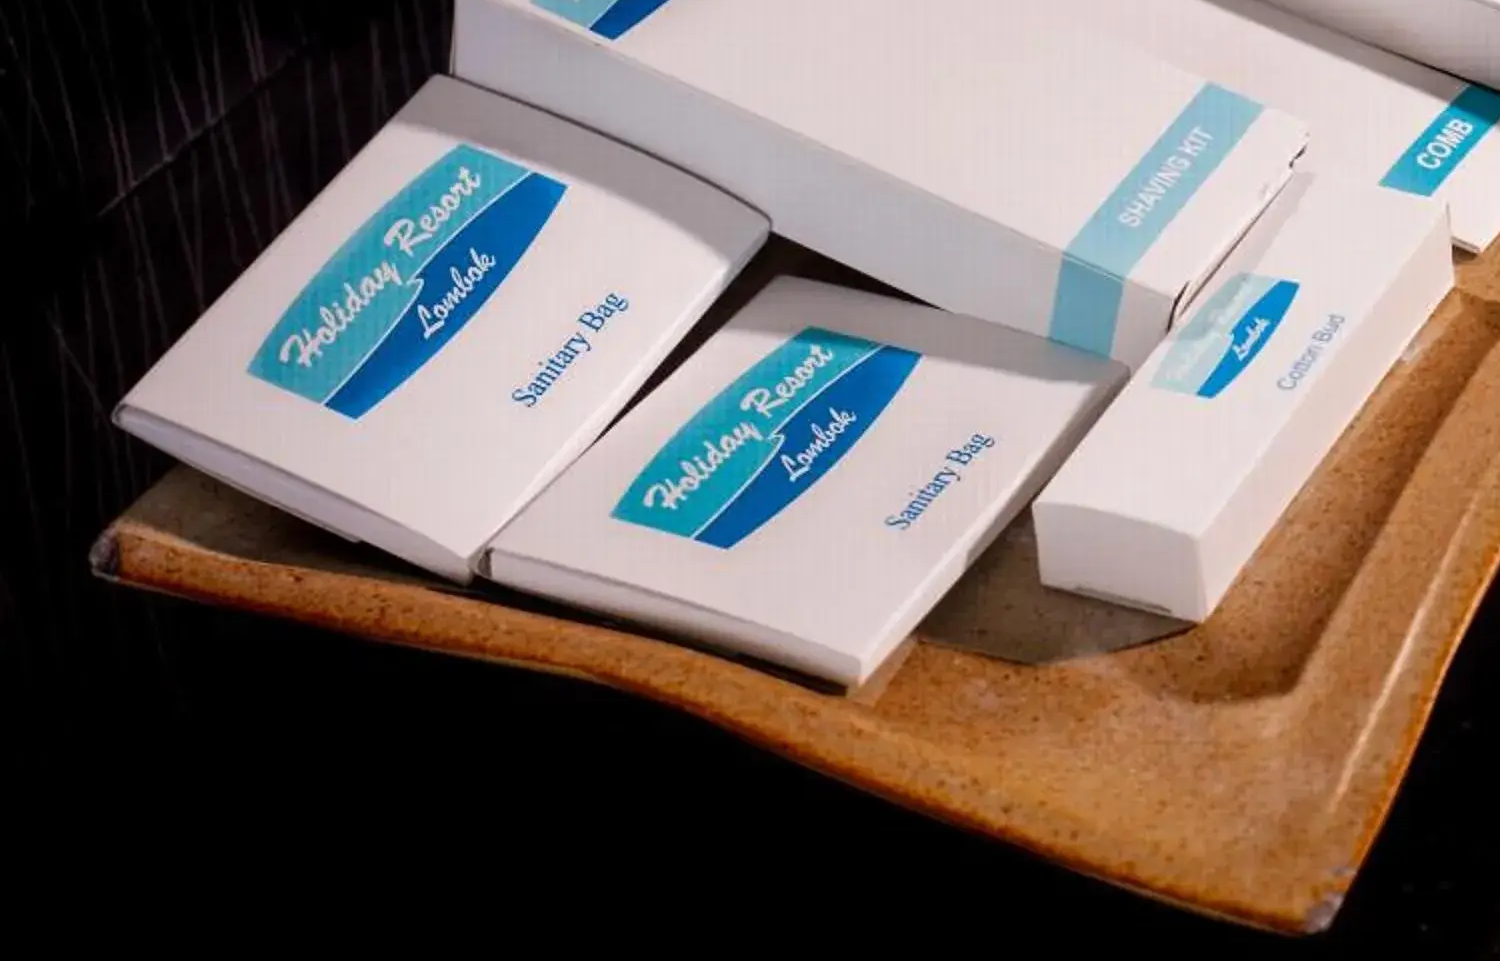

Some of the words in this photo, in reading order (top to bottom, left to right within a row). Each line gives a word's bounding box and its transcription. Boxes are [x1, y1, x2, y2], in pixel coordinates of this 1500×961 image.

[1116, 154, 1192, 229] SHAVING
[1182, 125, 1216, 159] KIT
[1415, 117, 1475, 171] COMB
[279, 257, 402, 369] Holiday
[383, 166, 481, 258] Resort
[415, 247, 497, 339] Lombok
[511, 331, 593, 409] Sanitary
[579, 291, 630, 334] Bag
[1311, 312, 1346, 344] Bud
[642, 419, 762, 511] Holiday
[739, 342, 834, 419] Resort
[779, 406, 857, 483] Lombok
[884, 461, 962, 531] Sanitary
[947, 430, 995, 468] Bag
